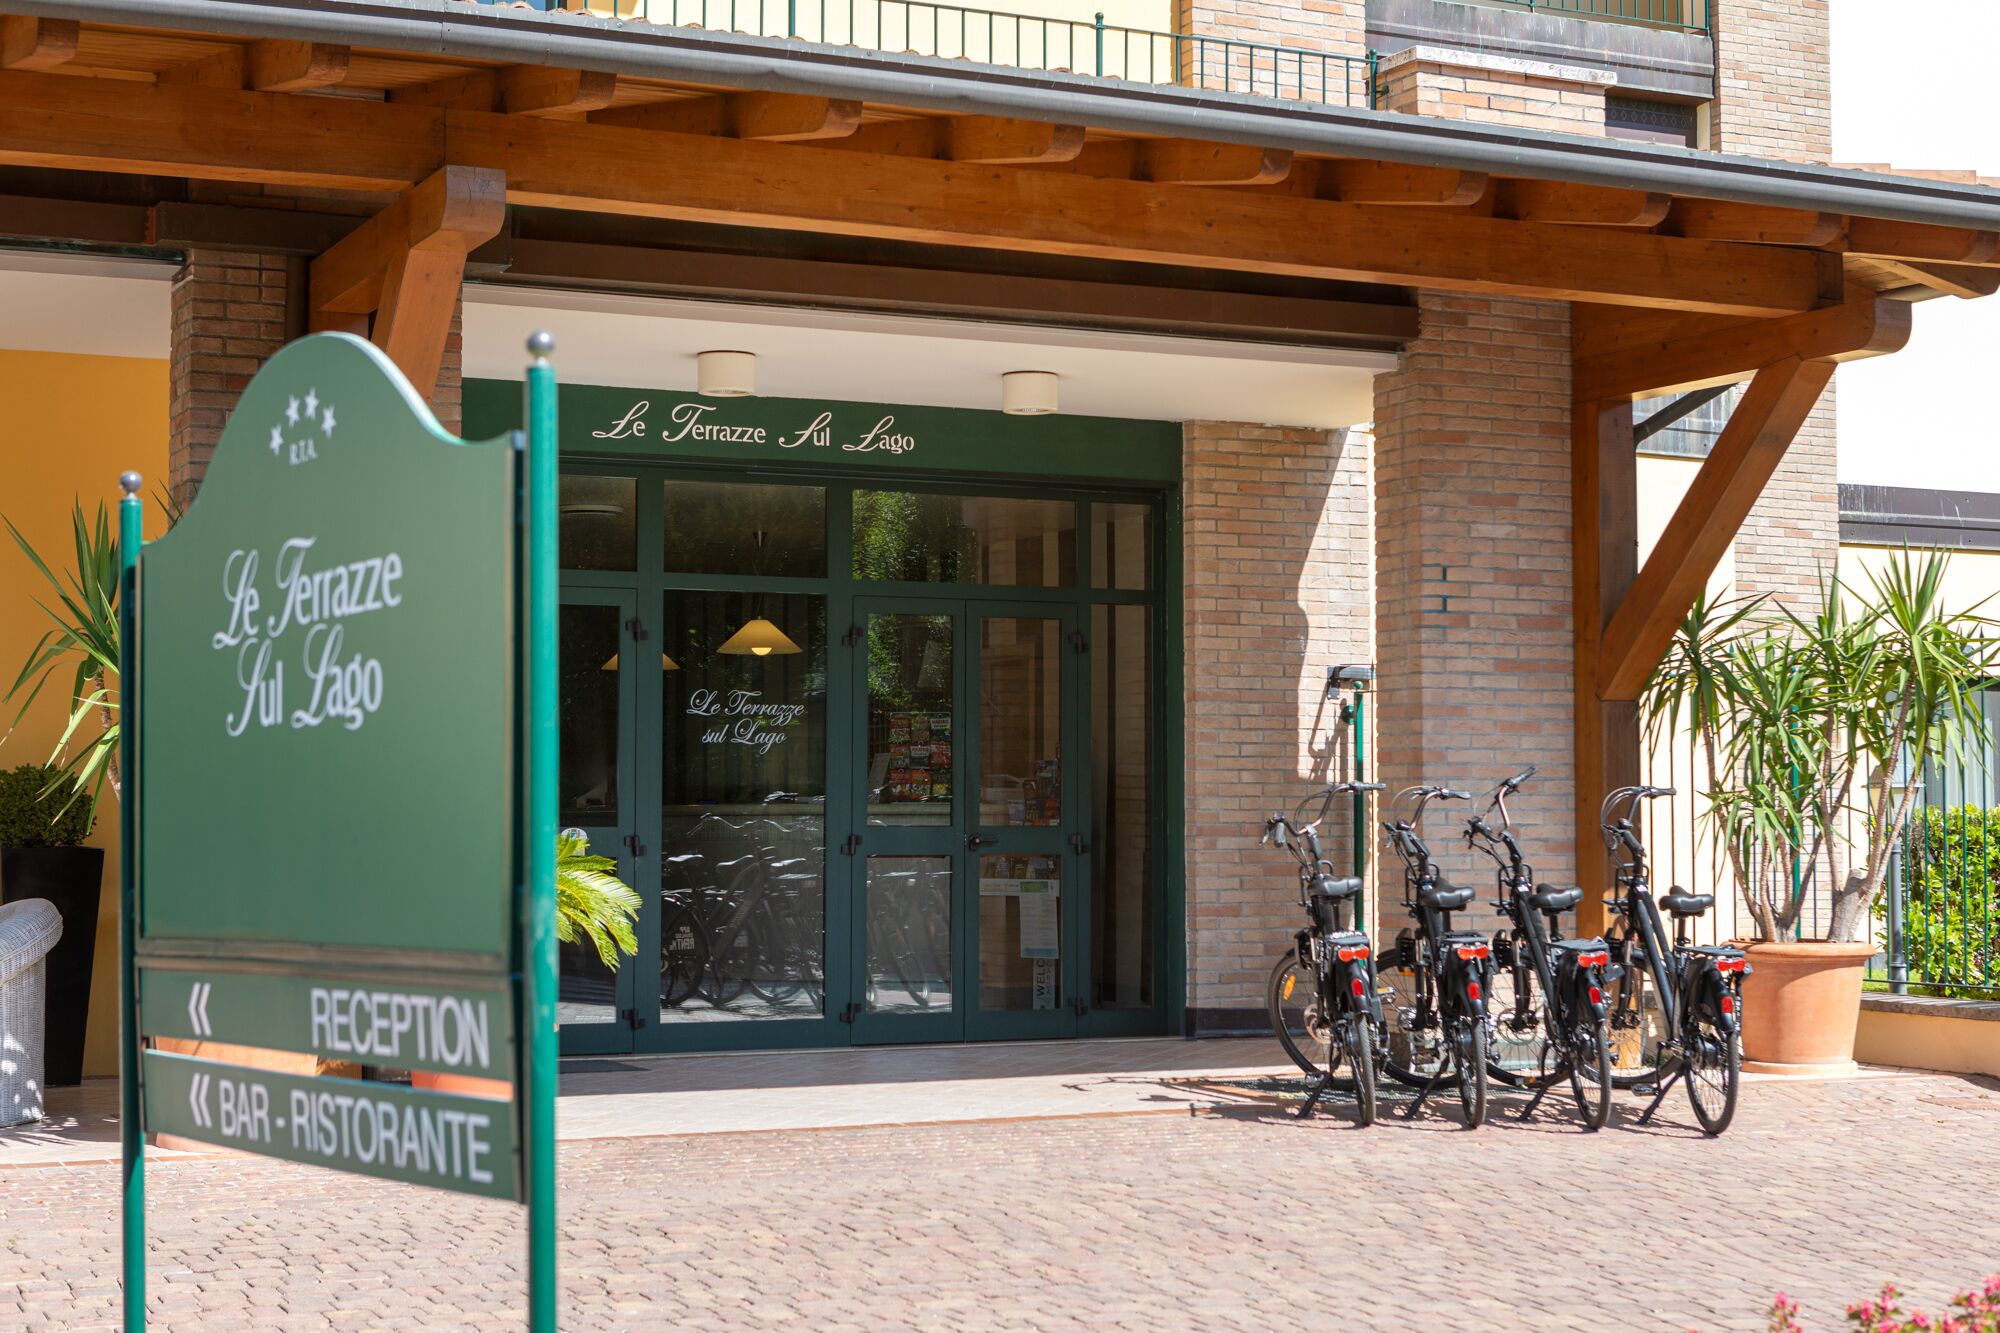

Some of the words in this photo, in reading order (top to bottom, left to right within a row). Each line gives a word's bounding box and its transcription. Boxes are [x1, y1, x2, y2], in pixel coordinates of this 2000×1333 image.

[592, 401, 650, 439] Le
[662, 403, 766, 444] Terrazze
[779, 411, 832, 448] Sul
[842, 415, 915, 454] Lago
[212, 549, 261, 650] Le
[267, 536, 403, 637] Terrazze
[226, 637, 284, 737] Sul
[290, 623, 383, 730] Lago
[686, 688, 721, 716] Le
[724, 690, 805, 726] Terrazze
[702, 724, 730, 744] sul
[731, 718, 787, 754] Lago
[311, 987, 489, 1068] RECEPTION
[218, 1079, 272, 1144] BAR
[291, 1088, 494, 1183] RISTORANTE
